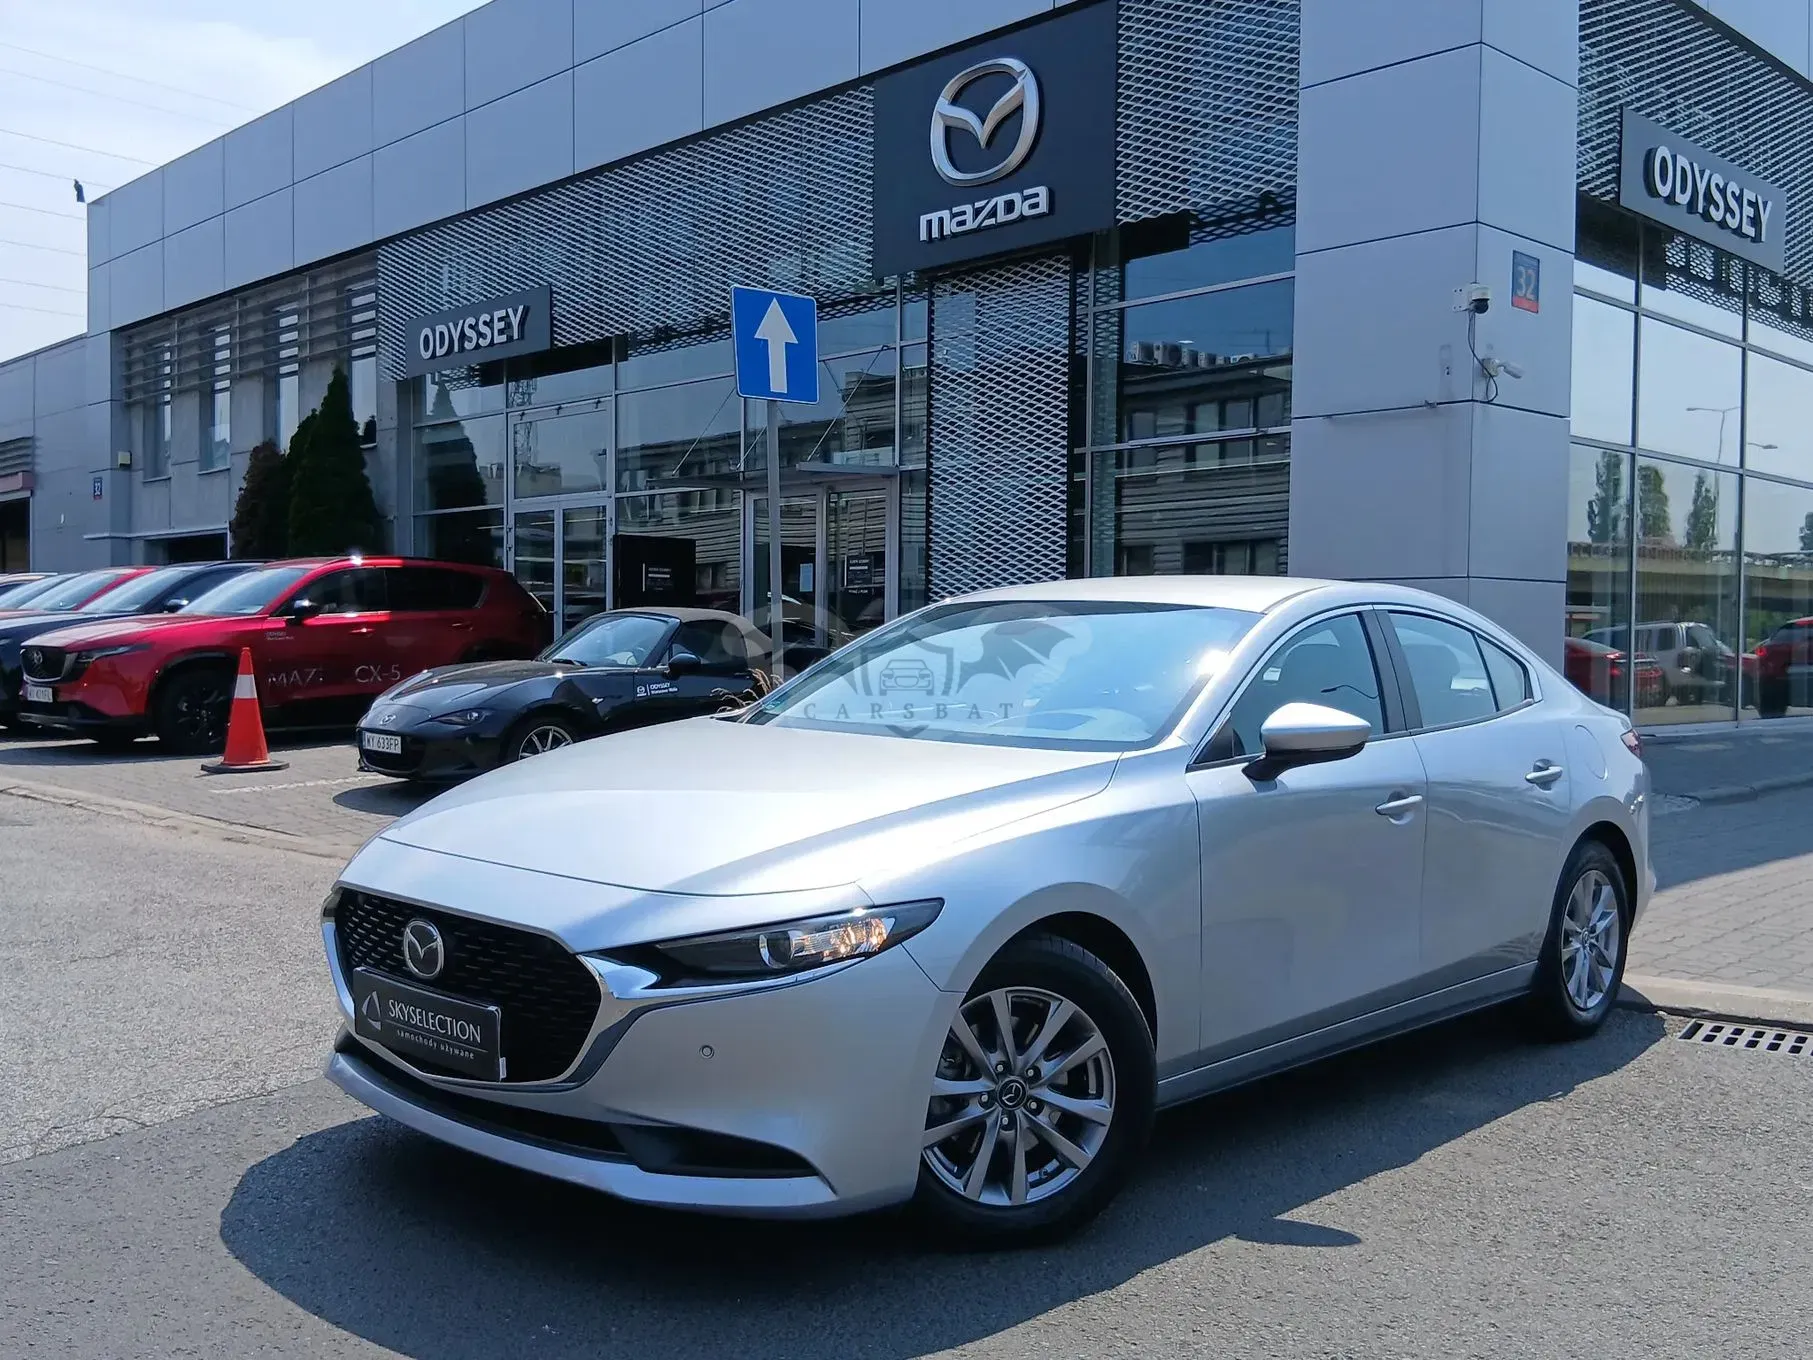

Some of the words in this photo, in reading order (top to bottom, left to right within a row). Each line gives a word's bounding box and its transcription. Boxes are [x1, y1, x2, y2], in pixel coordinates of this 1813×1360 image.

[1653, 145, 1773, 242] ODYSSEY
[1516, 265, 1537, 302] 32
[419, 304, 524, 360] ODYSSEY
[355, 664, 401, 683] CX-5
[376, 735, 400, 752] 633FP
[388, 999, 482, 1044] SKYSELECTION
[397, 1029, 438, 1050] samochody
